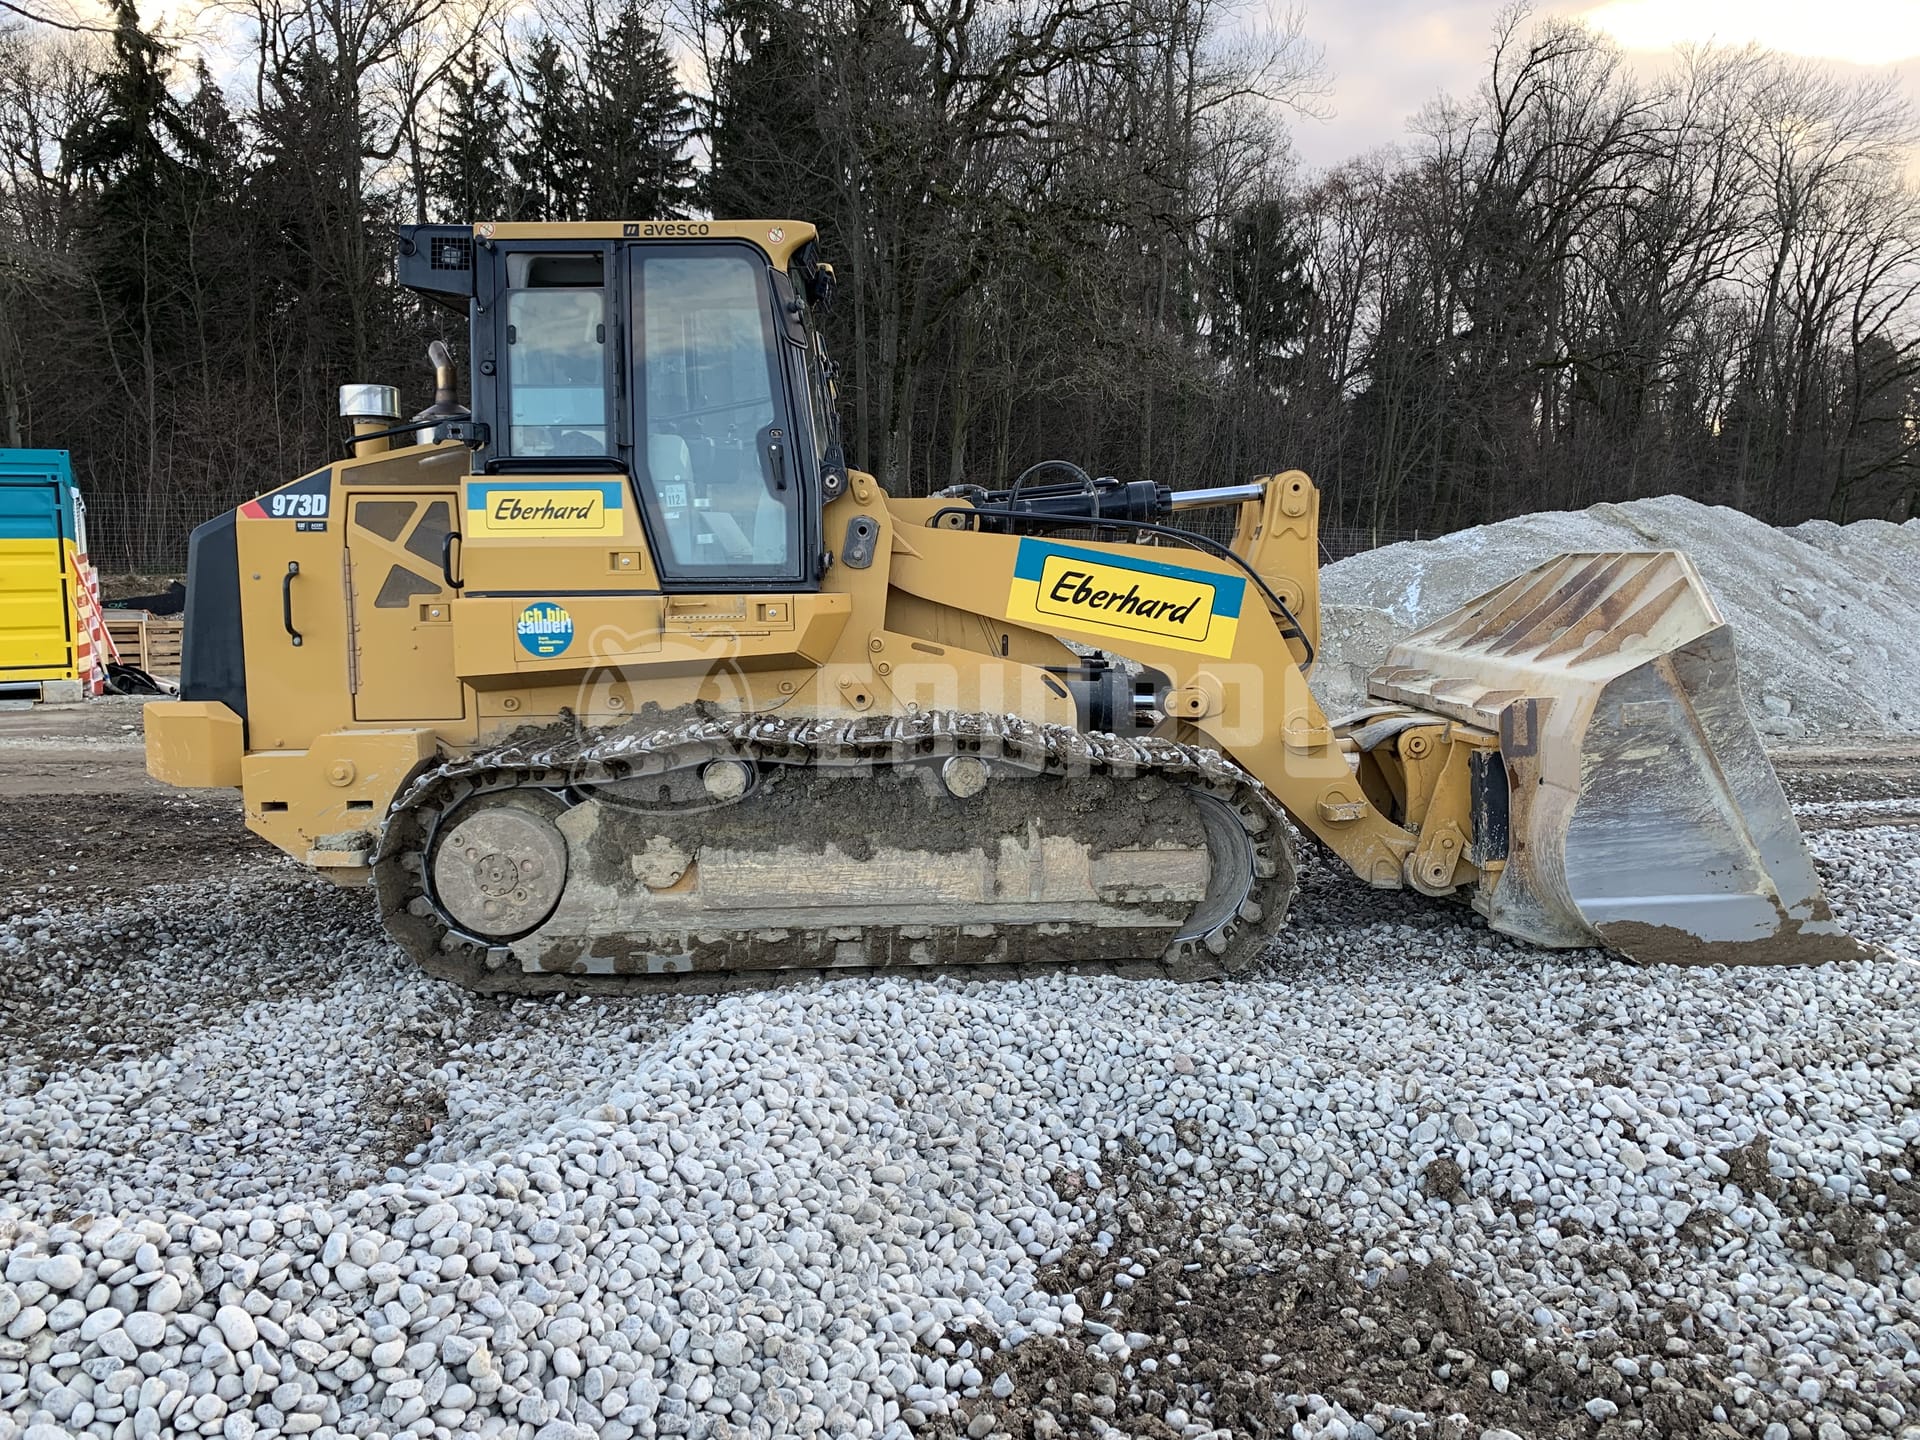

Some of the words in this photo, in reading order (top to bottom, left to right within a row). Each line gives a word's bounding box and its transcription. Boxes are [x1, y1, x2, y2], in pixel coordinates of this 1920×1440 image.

[643, 223, 709, 236] avesco
[272, 494, 327, 516] 973D
[494, 498, 595, 520] Eberhard
[1049, 570, 1202, 625] Eberhard
[517, 618, 573, 635] sauber!
